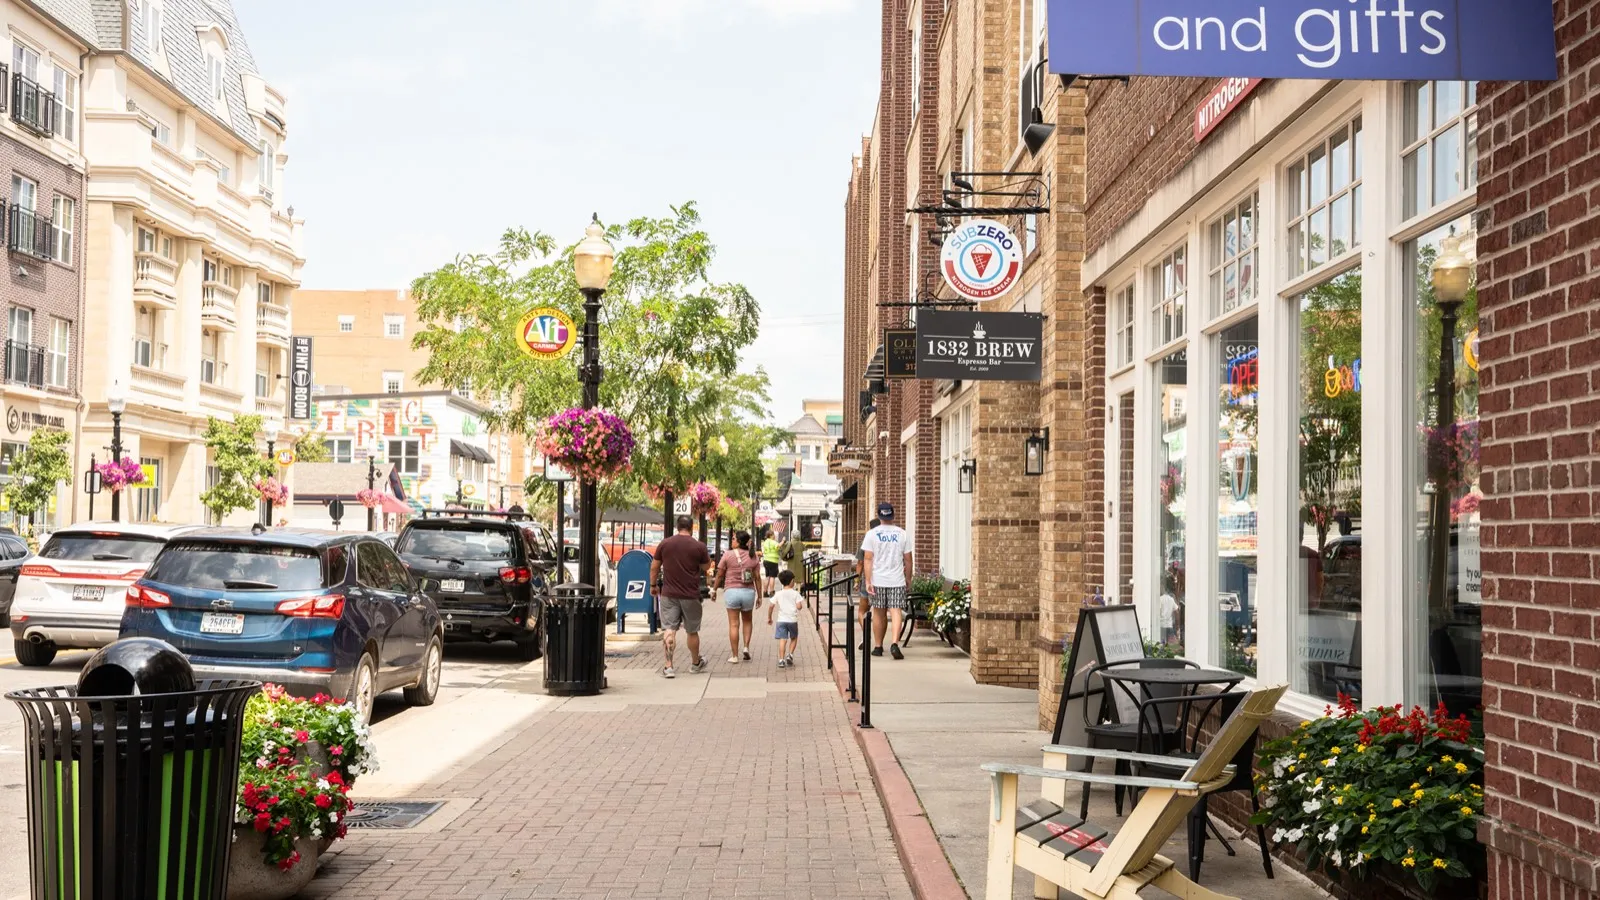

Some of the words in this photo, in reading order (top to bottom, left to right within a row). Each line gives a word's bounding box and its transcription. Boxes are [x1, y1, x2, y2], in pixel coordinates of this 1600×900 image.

[1153, 7, 1267, 51] and
[1294, 0, 1447, 68] gifts
[951, 225, 1013, 250] SUBZERO
[952, 275, 979, 296] NITROGEN
[993, 277, 1011, 294] CREAM
[523, 311, 539, 323] ARTS
[547, 310, 571, 326] DESIGN
[525, 317, 567, 344] Art
[296, 346, 309, 370] PINT
[529, 349, 563, 359] DISTRICT
[927, 340, 969, 356] 1832
[975, 342, 1034, 358] BREW
[957, 357, 987, 366] Espresso
[989, 358, 1001, 366] Bar
[1231, 357, 1258, 400] OPE
[294, 387, 308, 418] ROOM
[676, 503, 687, 512] 20
[1466, 567, 1474, 581] try
